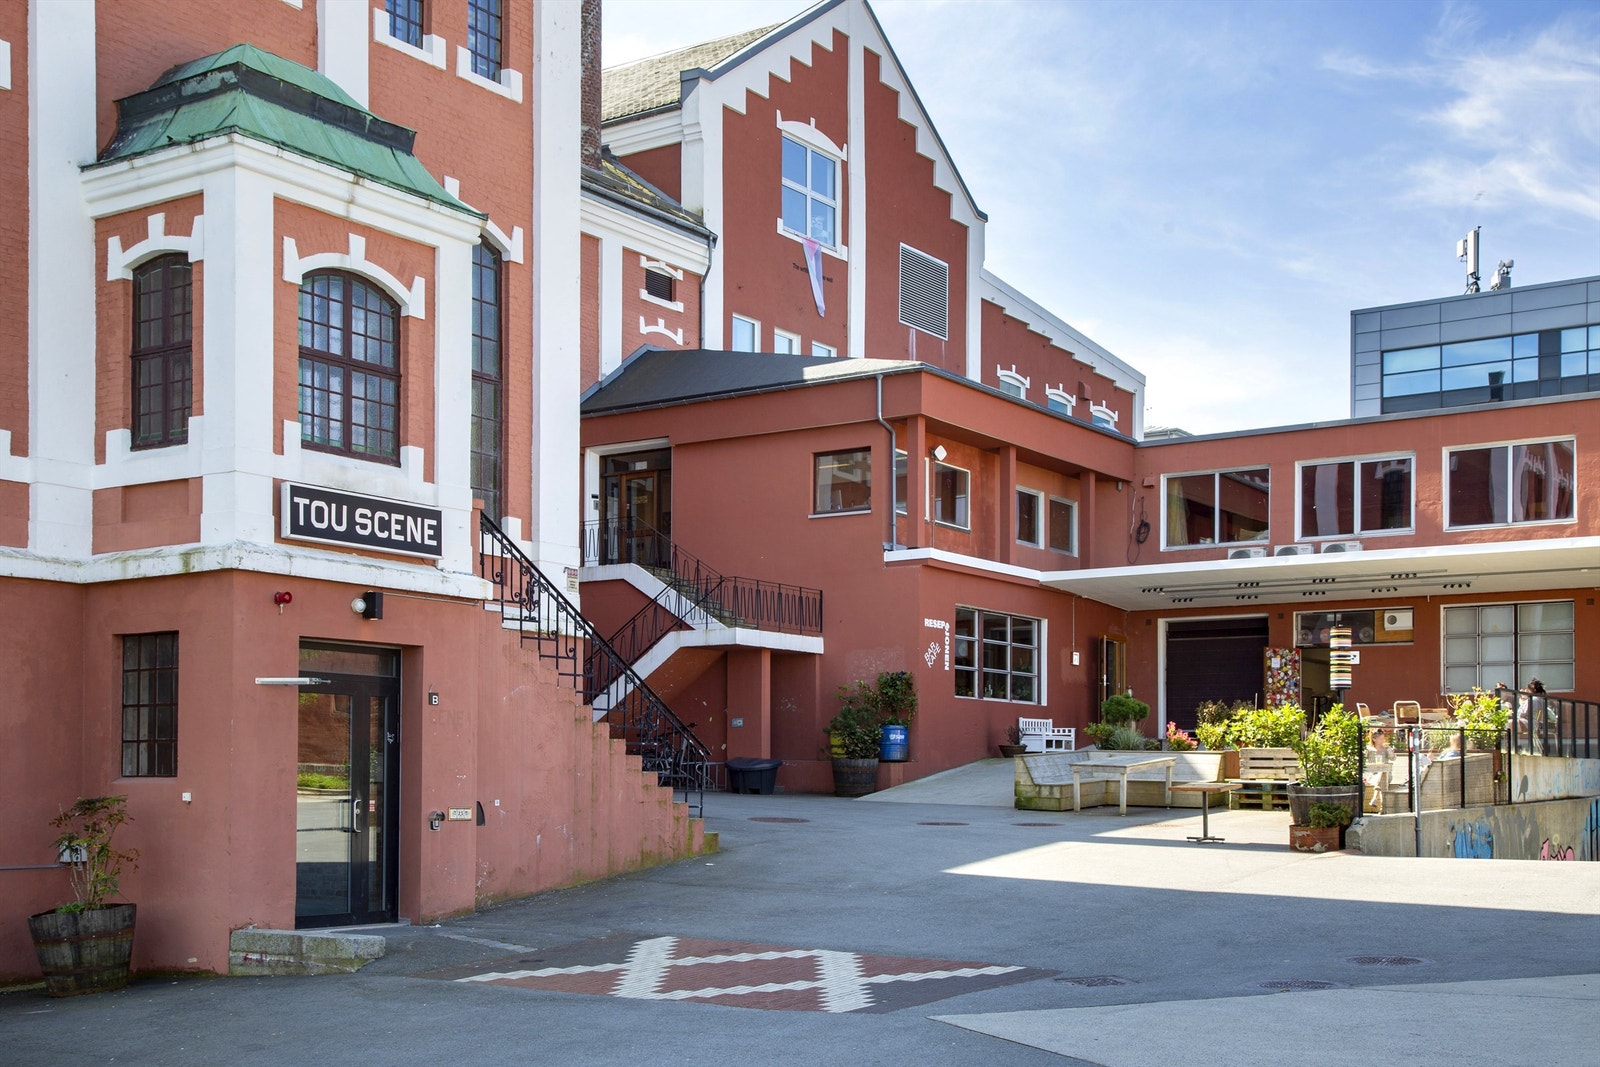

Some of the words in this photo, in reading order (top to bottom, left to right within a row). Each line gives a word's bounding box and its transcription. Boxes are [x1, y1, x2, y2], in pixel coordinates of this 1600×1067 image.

[293, 496, 348, 532] TOU
[354, 507, 438, 546] SCENE
[924, 641, 936, 662] BAR
[432, 695, 439, 705] B
